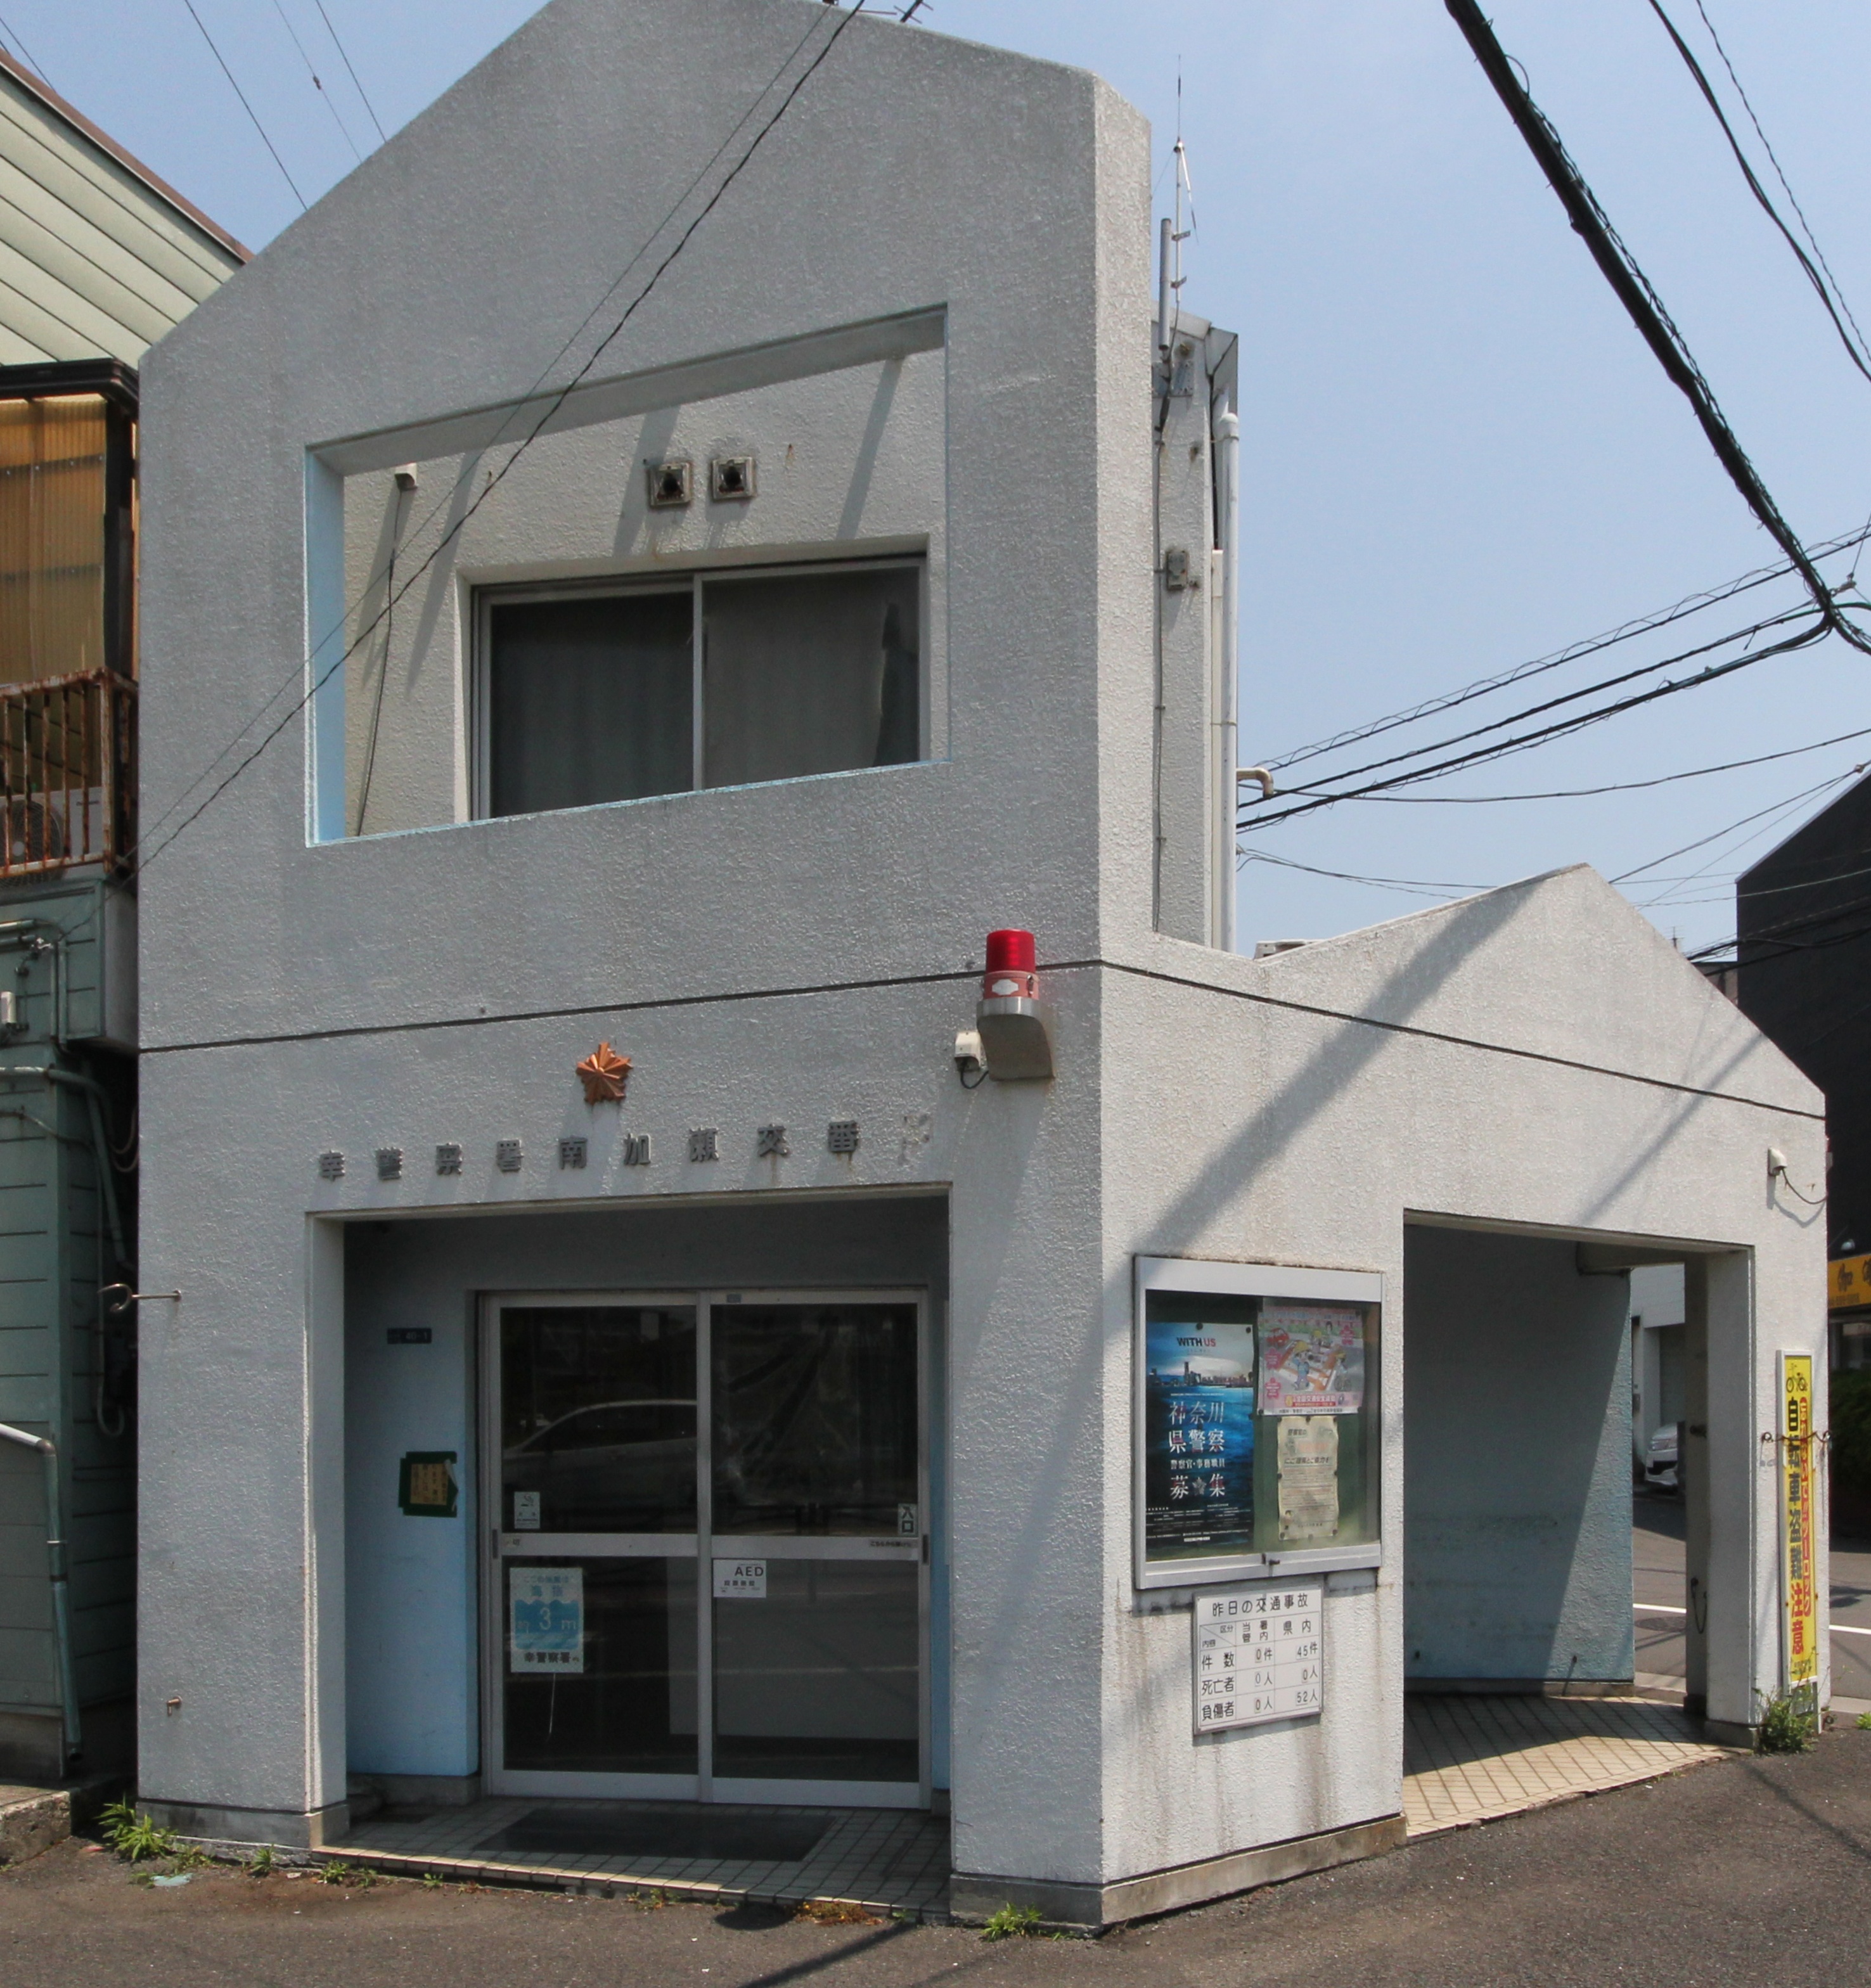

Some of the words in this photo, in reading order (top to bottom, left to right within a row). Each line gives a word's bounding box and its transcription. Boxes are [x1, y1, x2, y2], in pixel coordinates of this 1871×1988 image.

[319, 1120, 859, 1180] 幸警察署南加瀬交番
[1177, 1337, 1202, 1347] WITH
[1204, 1338, 1216, 1347] US
[1169, 1401, 1224, 1425] 神奈川
[1169, 1428, 1225, 1454] 県警察
[901, 1506, 914, 1533] 入口
[735, 1567, 764, 1577] AED
[1212, 1593, 1308, 1617] 昨日の交通事故
[539, 1607, 551, 1630] 3
[1283, 1619, 1312, 1636] 県内
[1201, 1651, 1235, 1671] 件数
[1201, 1677, 1235, 1696] 死亡者
[1201, 1701, 1235, 1722] 負傷者
